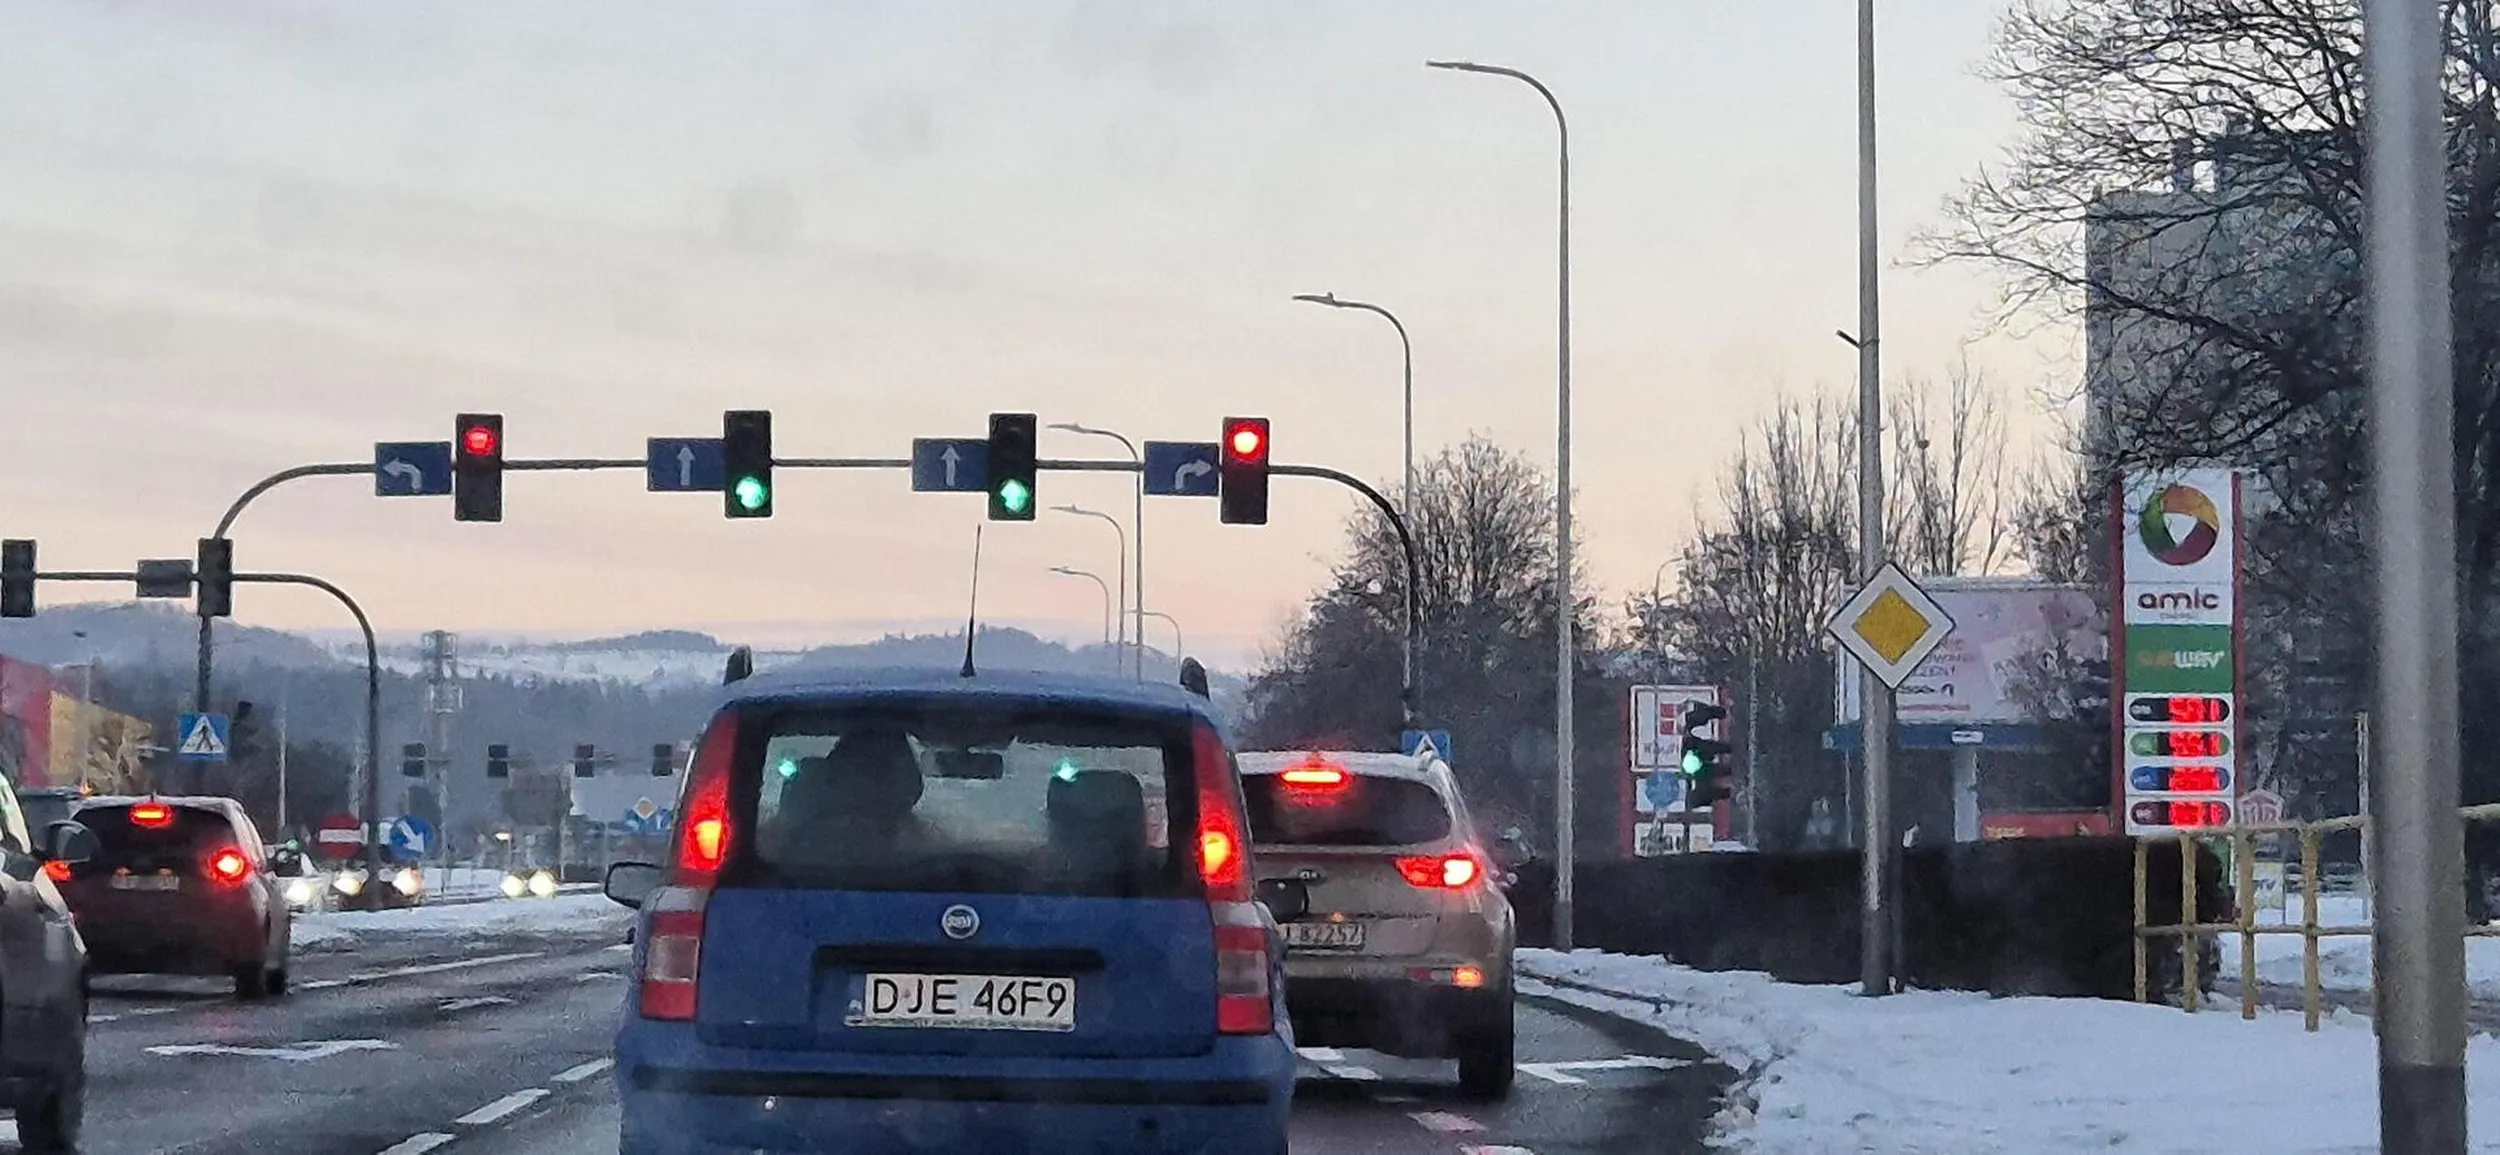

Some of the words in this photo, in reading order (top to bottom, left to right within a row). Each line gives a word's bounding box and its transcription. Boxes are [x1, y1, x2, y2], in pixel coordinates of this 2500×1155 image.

[2138, 587, 2220, 610] amic
[870, 977, 958, 1015] DJE
[973, 979, 1069, 1019] 46F9
